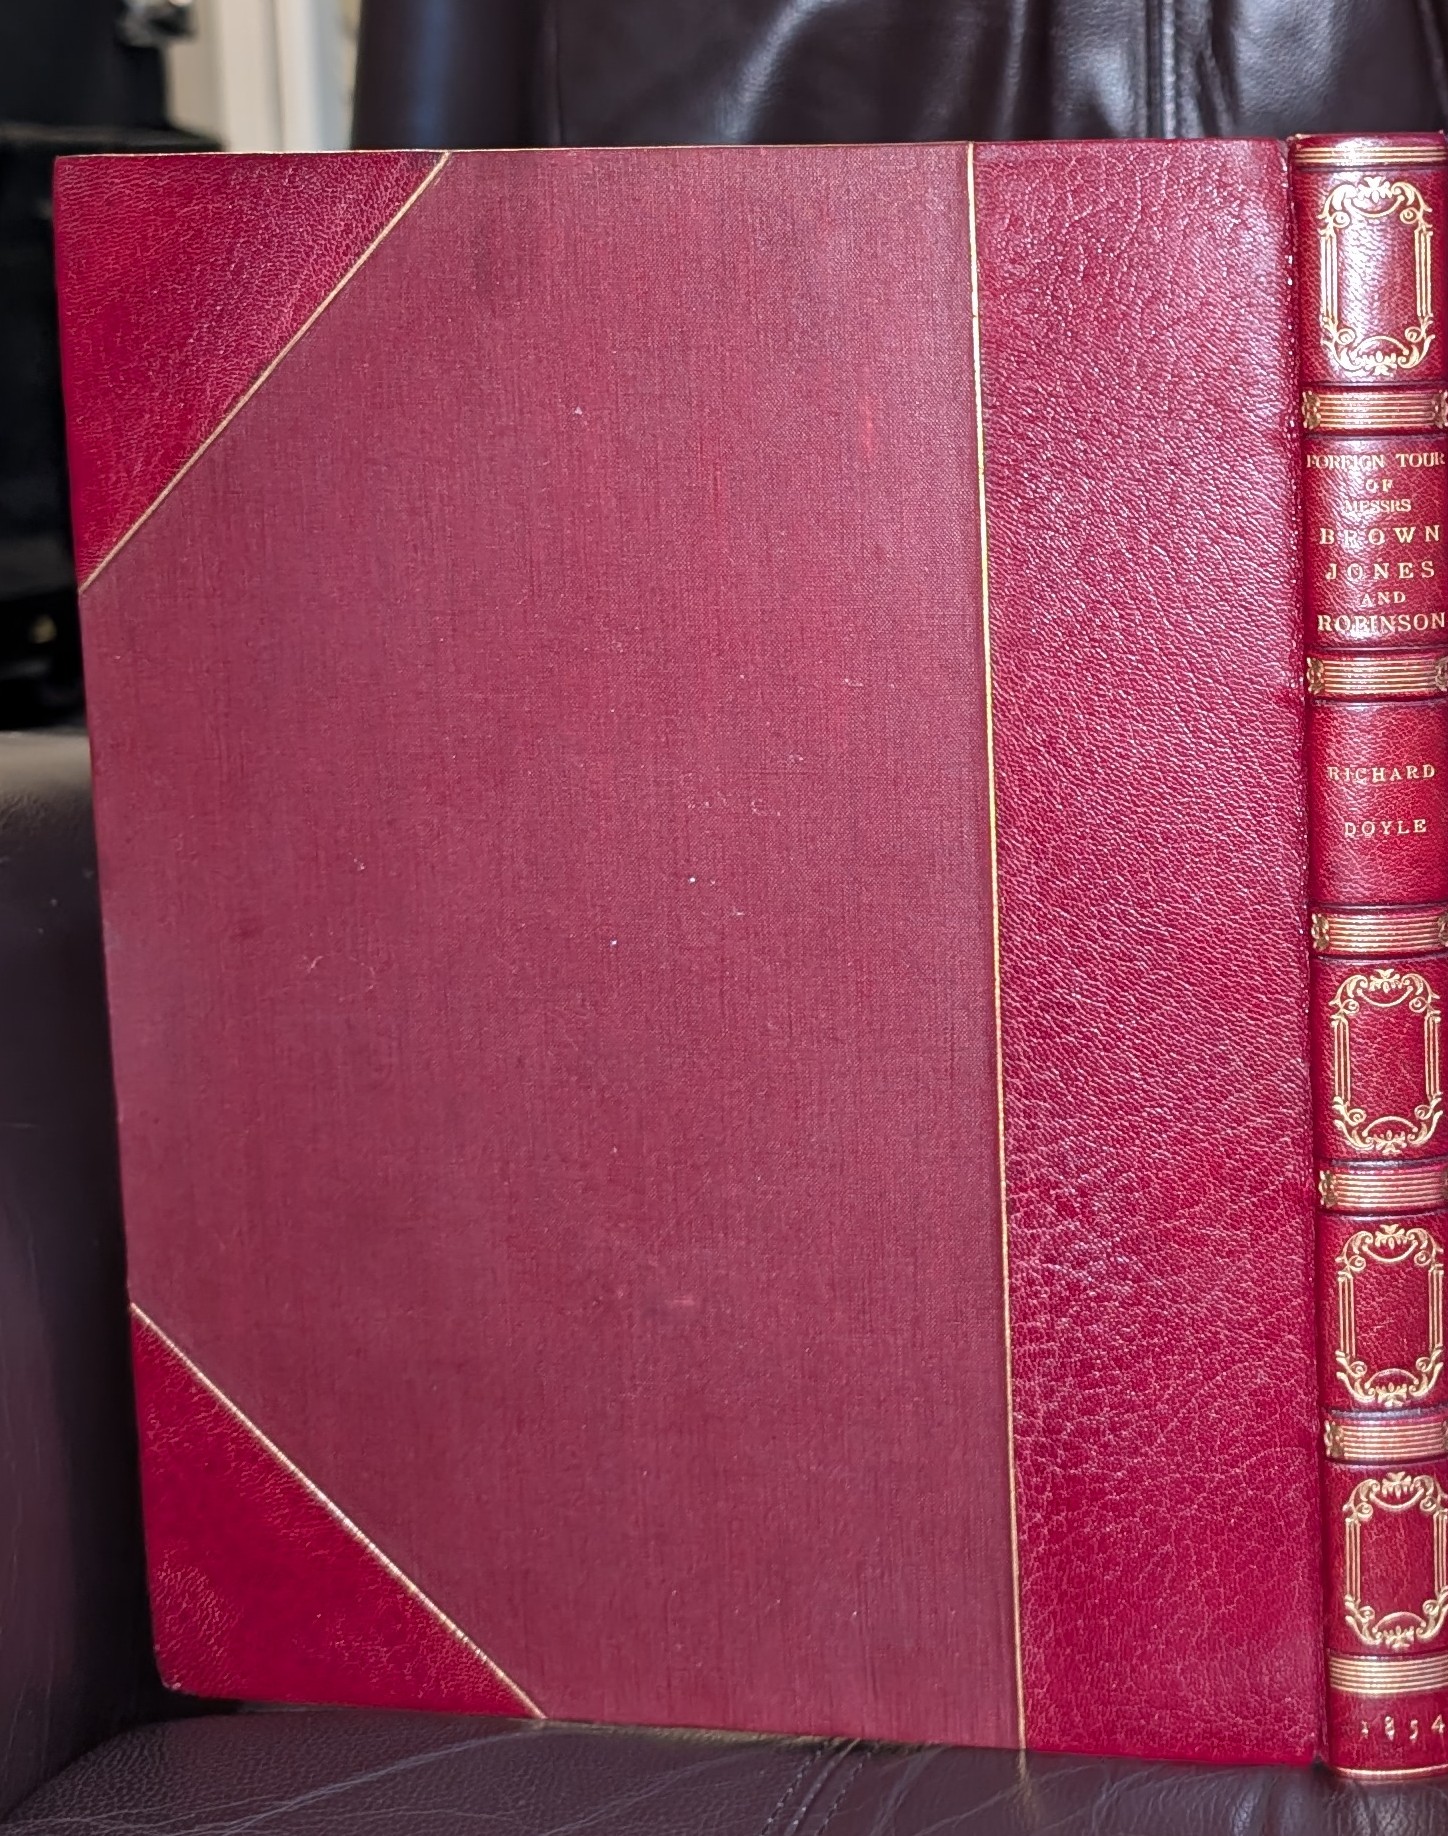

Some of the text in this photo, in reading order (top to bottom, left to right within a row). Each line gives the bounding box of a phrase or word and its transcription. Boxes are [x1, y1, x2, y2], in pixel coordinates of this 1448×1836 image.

[1395, 452, 1446, 468] TOUR
[1365, 478, 1393, 493] OF
[1319, 525, 1440, 548] BROWN
[1325, 561, 1435, 580] JONES
[1361, 591, 1406, 607] AND
[1317, 612, 1446, 632] ROBINSON
[1327, 764, 1436, 782] RICHARD
[1344, 819, 1427, 836] DOYLE
